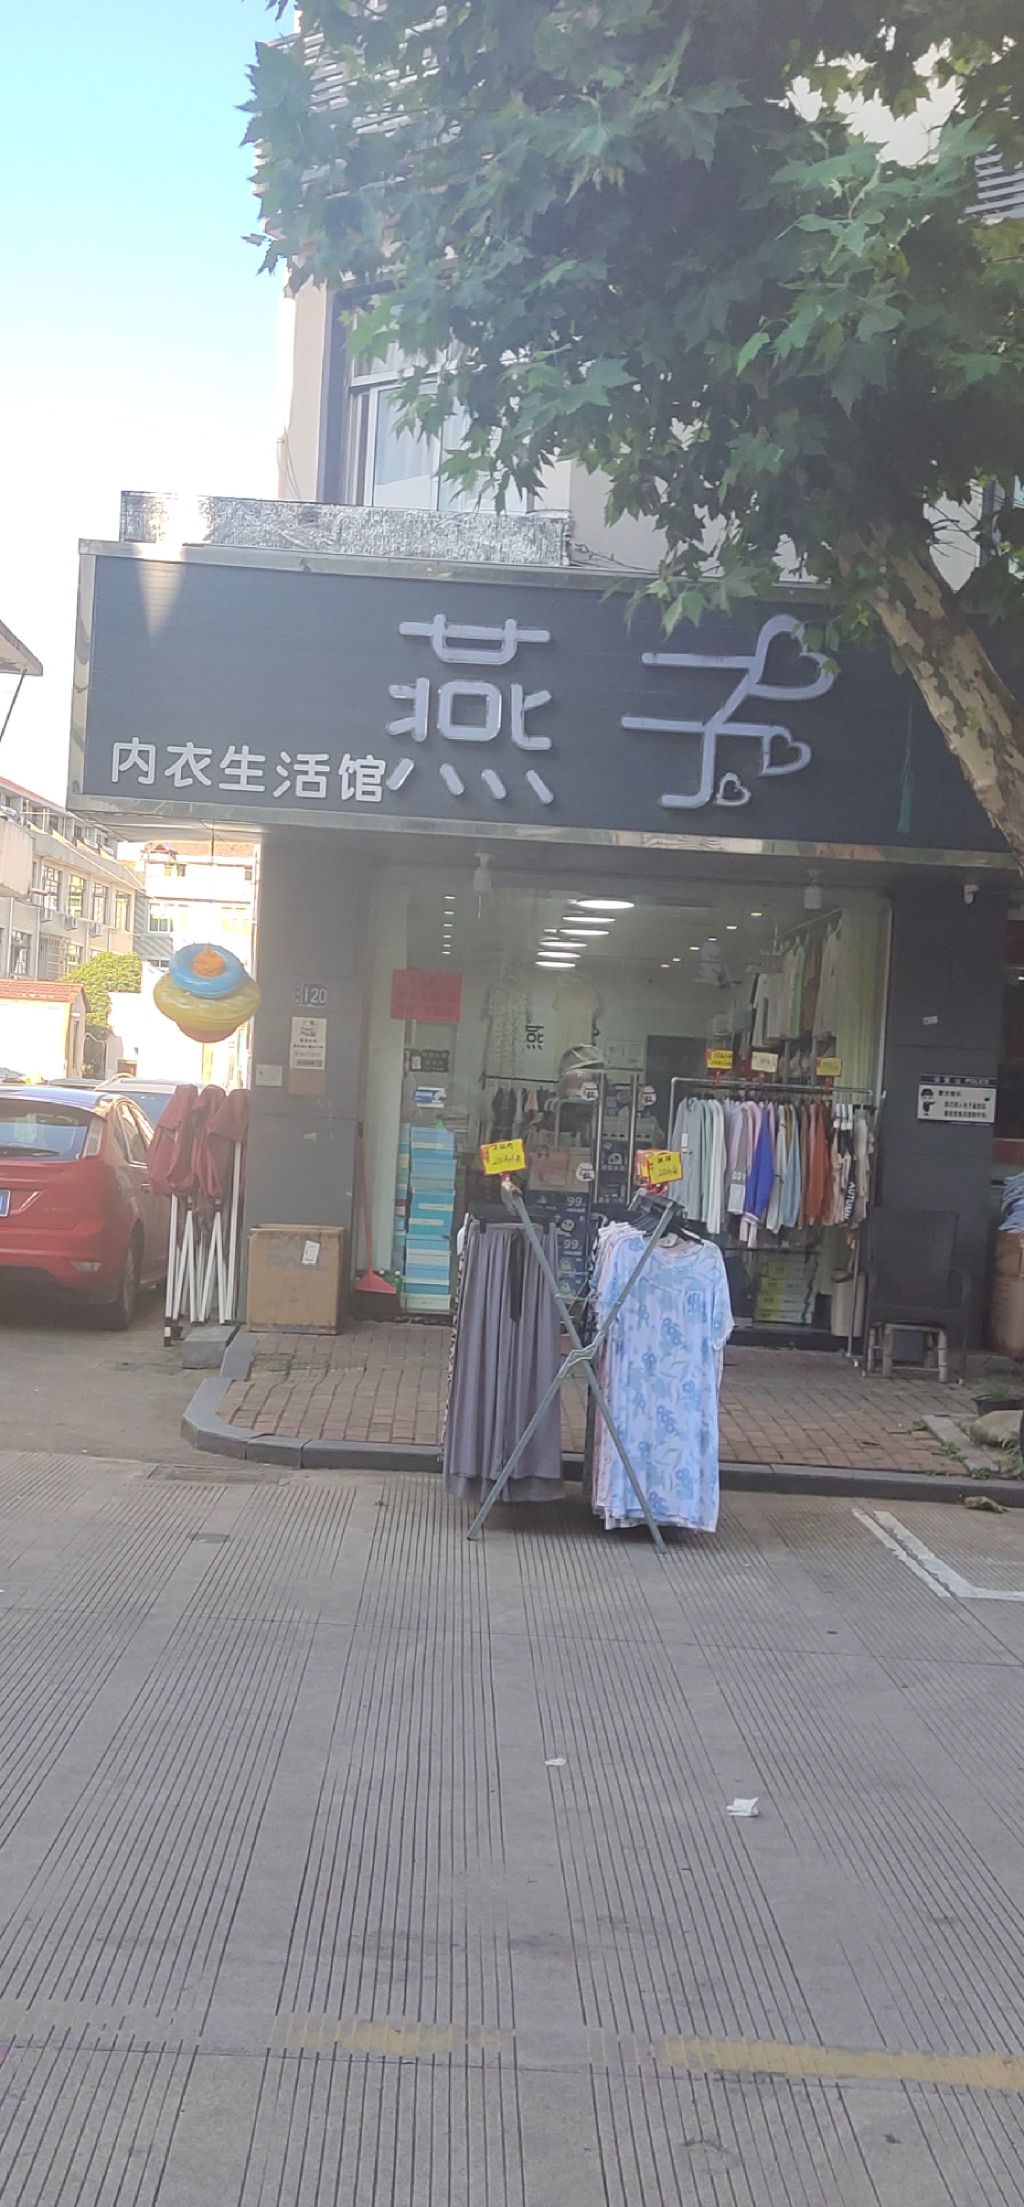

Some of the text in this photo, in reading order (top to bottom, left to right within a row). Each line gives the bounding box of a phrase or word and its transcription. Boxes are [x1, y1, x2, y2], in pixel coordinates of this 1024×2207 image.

[385, 613, 836, 808] 燕子
[111, 736, 386, 803] 内衣生活馆
[304, 987, 327, 1004] 120
